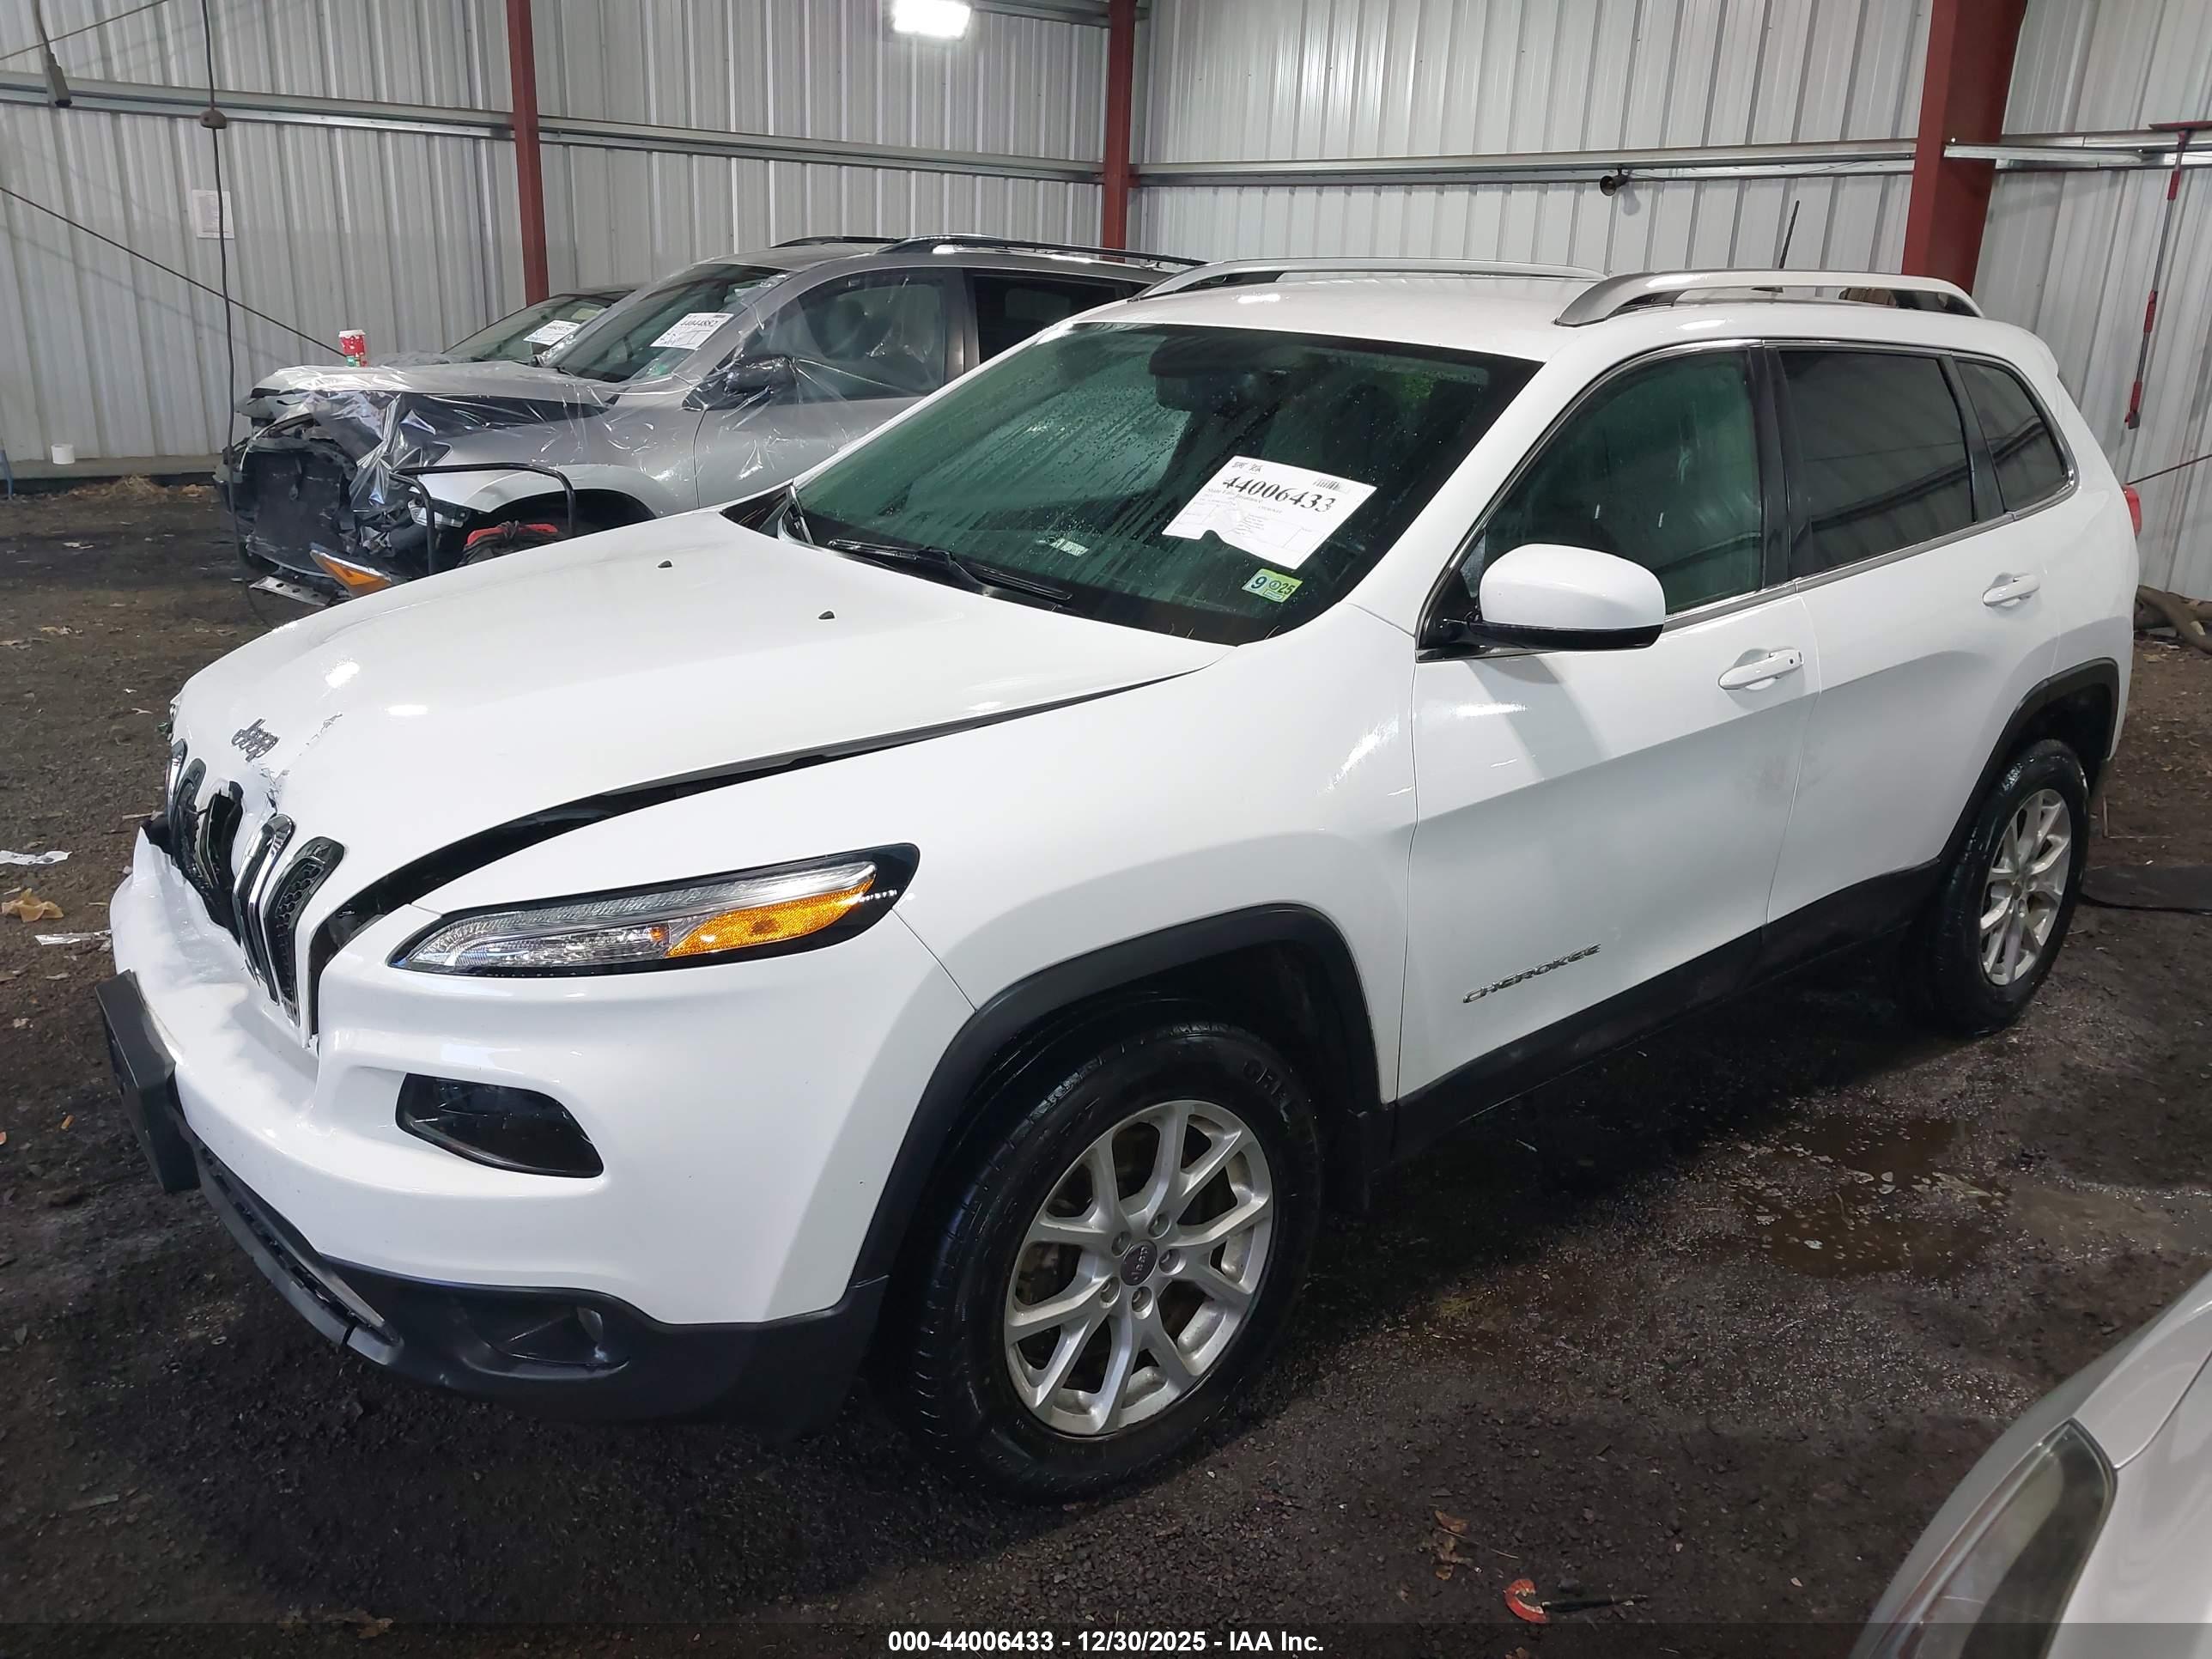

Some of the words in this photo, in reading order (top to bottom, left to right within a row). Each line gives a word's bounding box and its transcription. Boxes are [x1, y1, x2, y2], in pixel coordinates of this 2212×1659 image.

[1223, 475, 1337, 514] 44006433
[1250, 575, 1267, 589] 9
[1277, 582, 1296, 595] 25
[1463, 943, 1601, 1004] CHEROKEE
